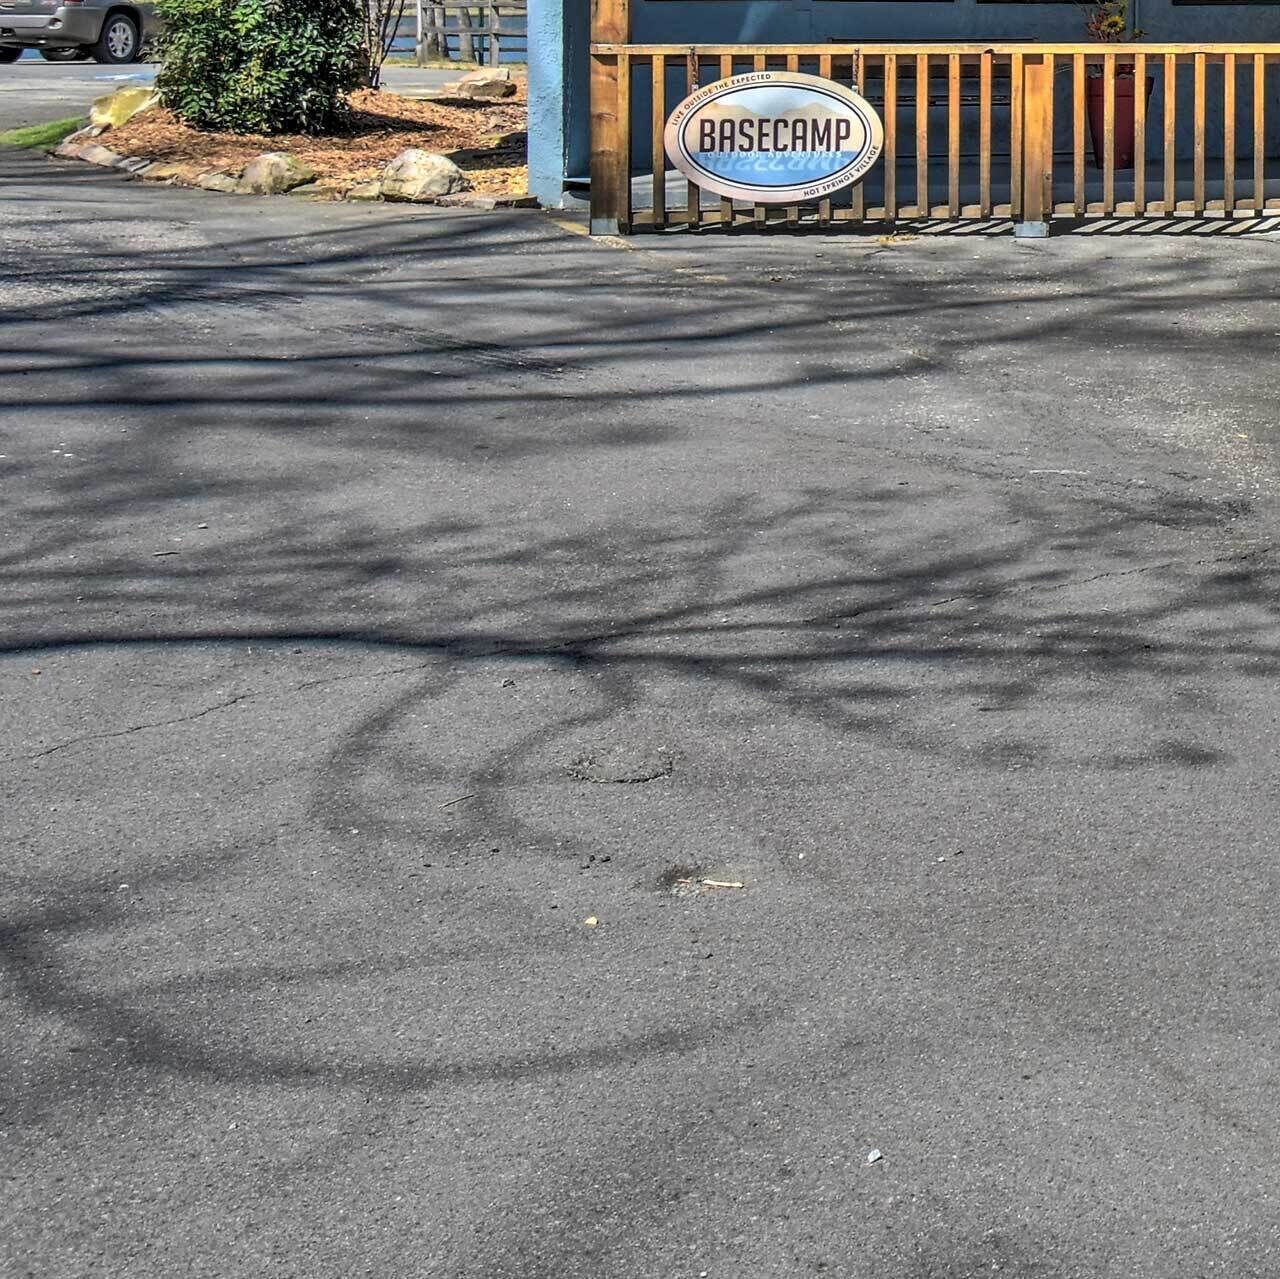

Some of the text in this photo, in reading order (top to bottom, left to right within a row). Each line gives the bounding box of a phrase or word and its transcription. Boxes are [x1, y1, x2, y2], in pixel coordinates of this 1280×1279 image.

[672, 73, 772, 126] LIVE OUTSIDE THE EXPECTED
[700, 118, 851, 152] BASECAMP
[803, 145, 880, 197] HOT SPRINGS VILLAGE
